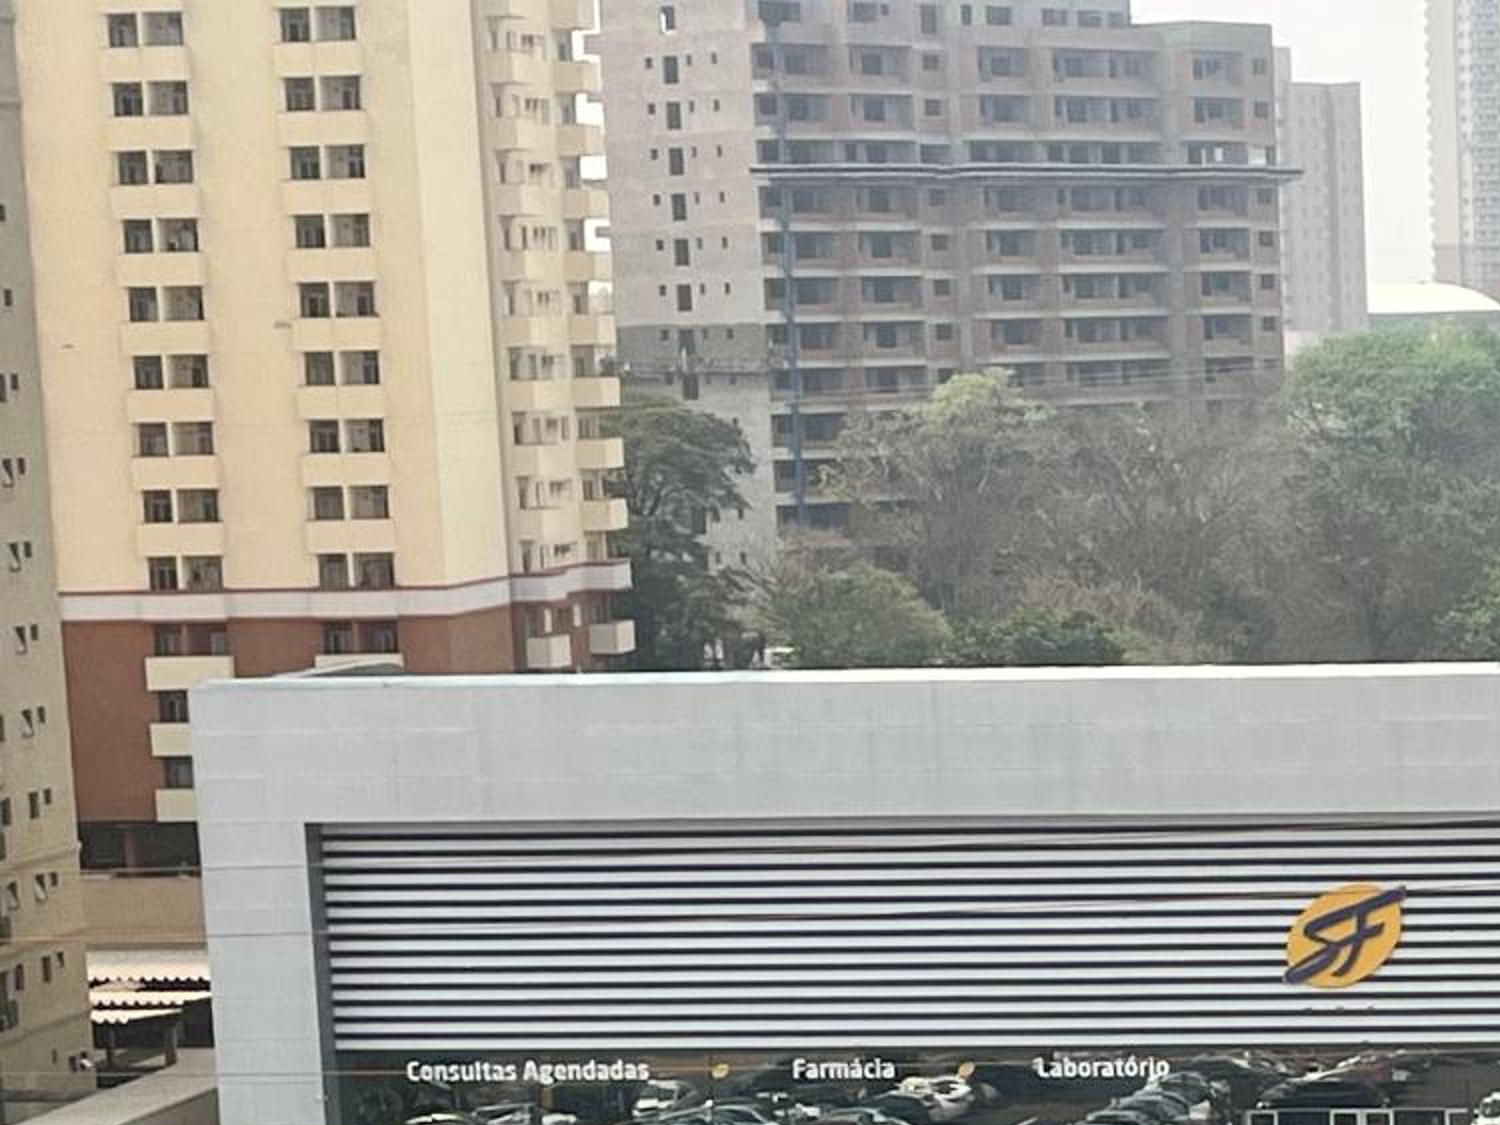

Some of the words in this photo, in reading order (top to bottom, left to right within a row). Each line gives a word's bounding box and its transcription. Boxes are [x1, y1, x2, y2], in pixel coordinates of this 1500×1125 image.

[406, 1061, 517, 1082] Consultas
[523, 1060, 650, 1085] Agendadas
[793, 1058, 895, 1079] Farmácia
[1037, 1055, 1170, 1078] Laboratório
